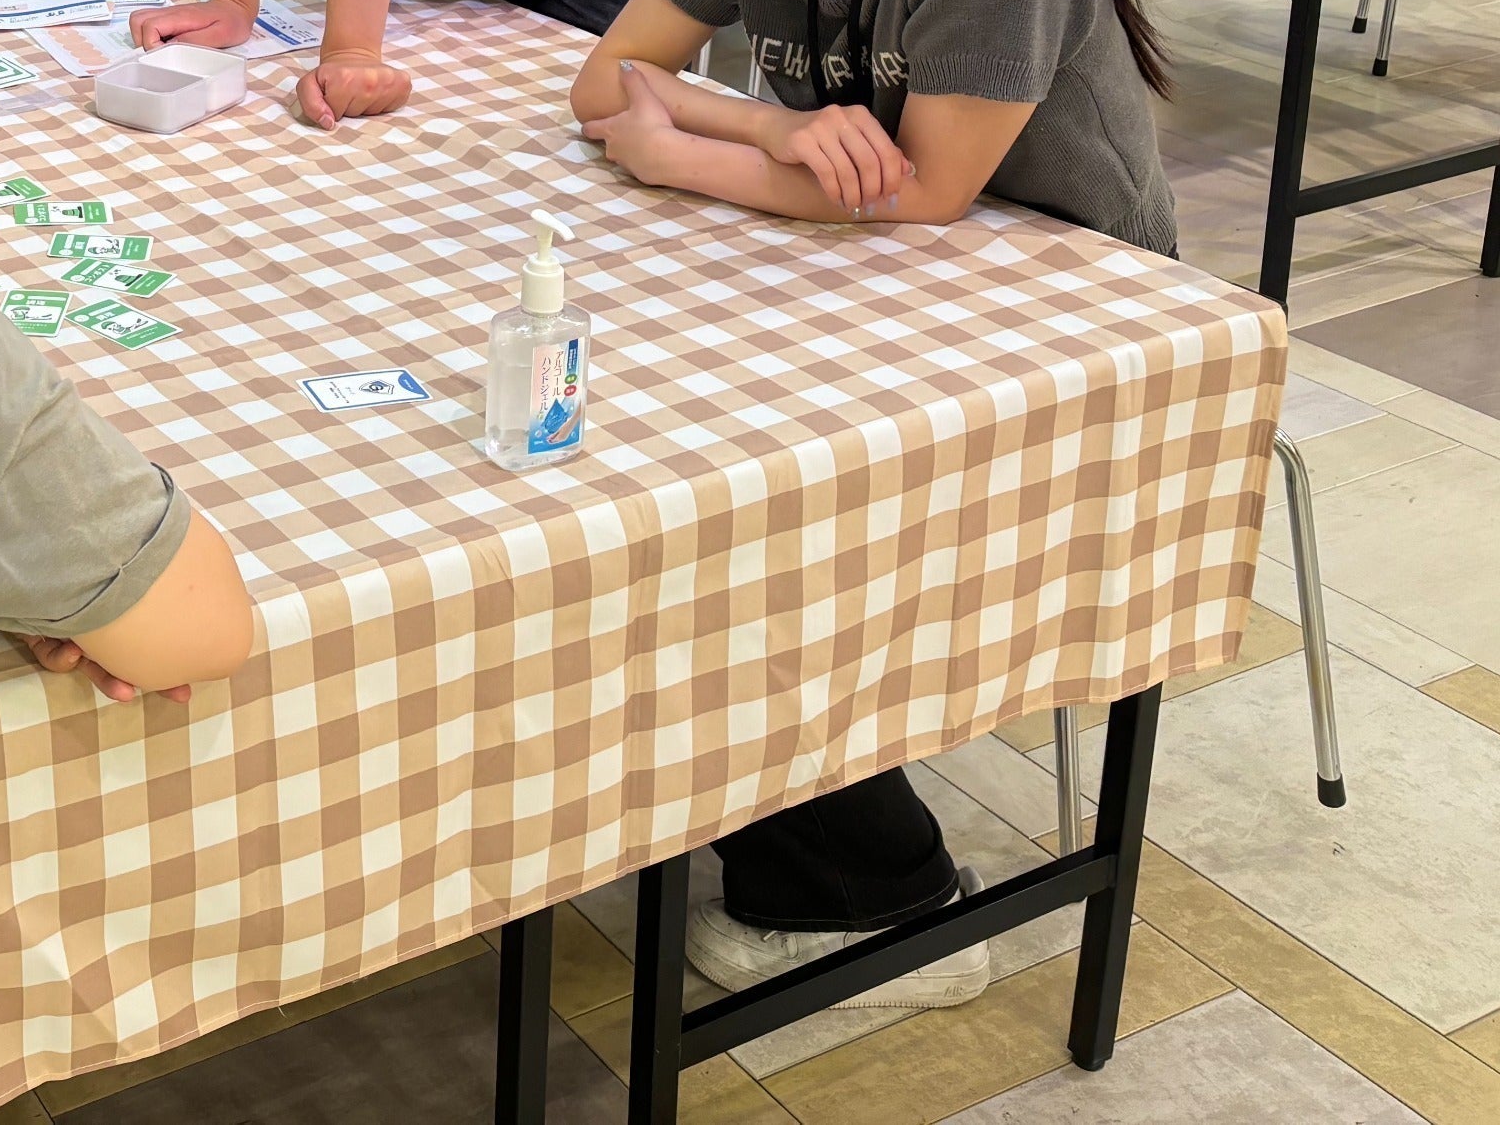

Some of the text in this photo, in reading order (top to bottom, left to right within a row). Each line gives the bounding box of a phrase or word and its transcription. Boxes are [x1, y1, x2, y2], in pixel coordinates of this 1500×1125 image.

[540, 356, 551, 411] ハンドジェル
[553, 350, 564, 397] アルコール
